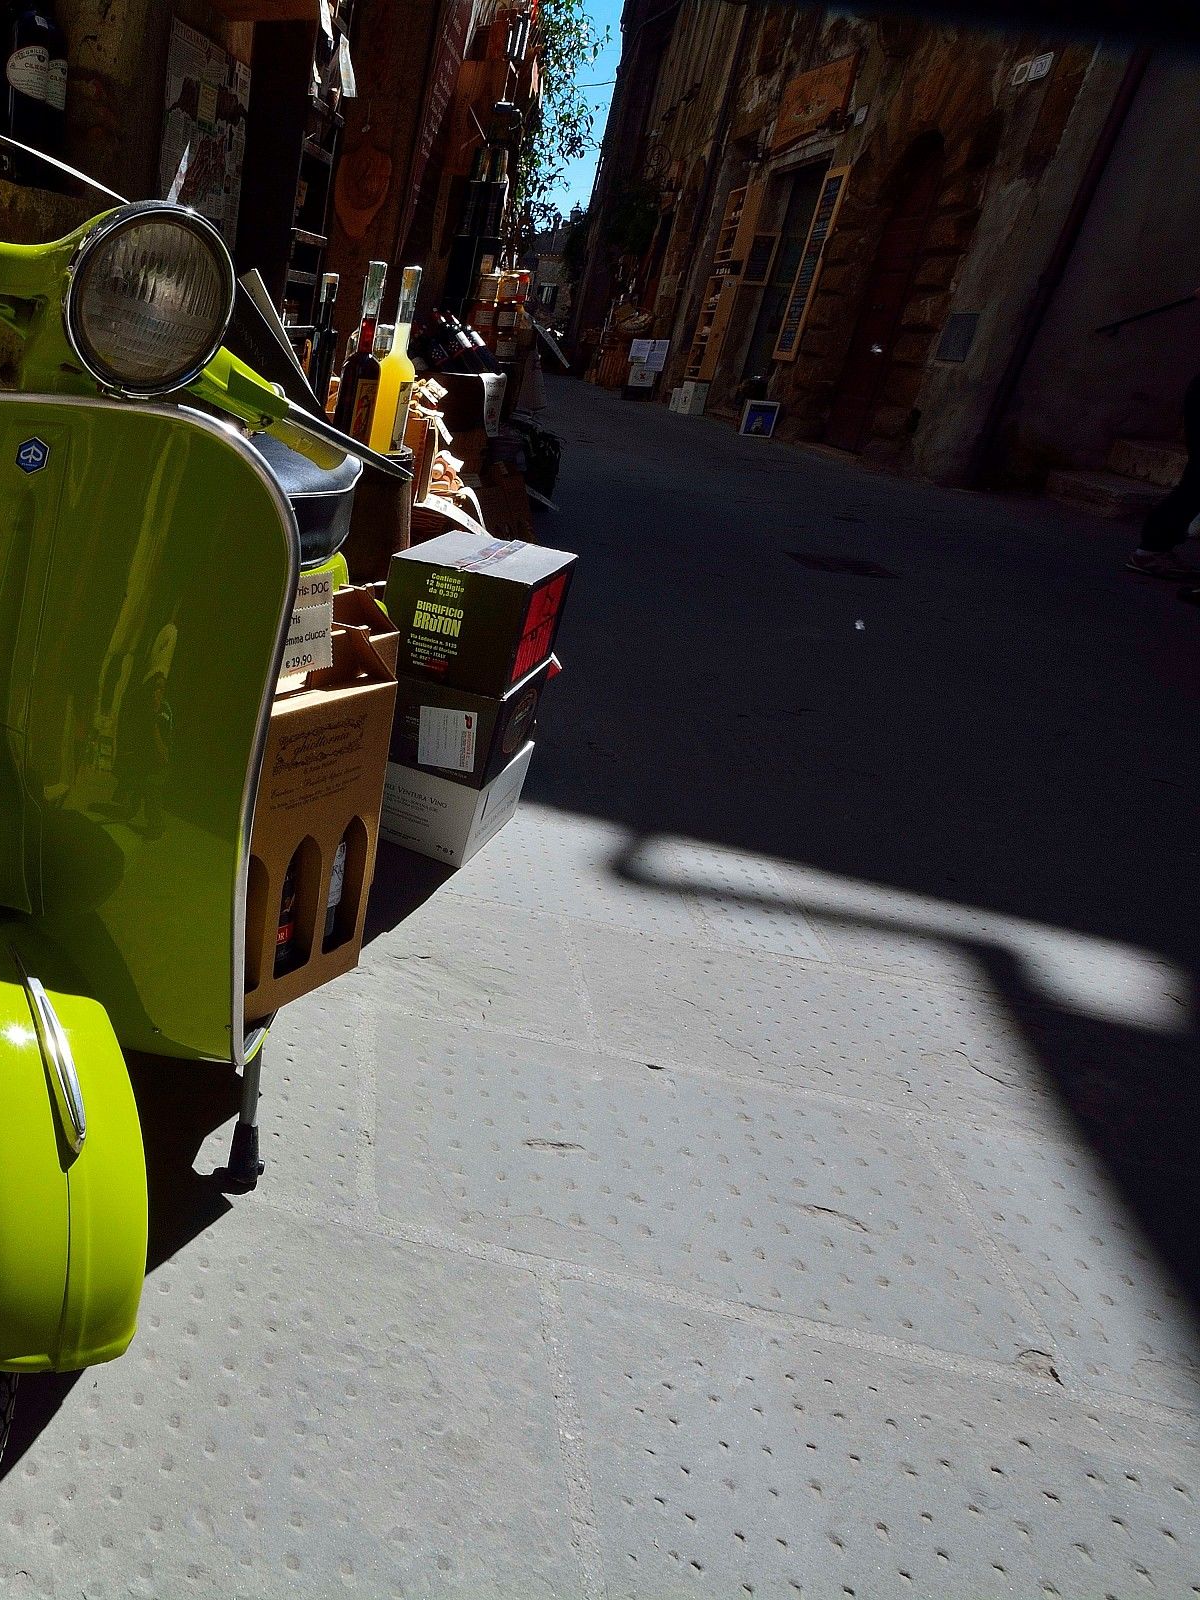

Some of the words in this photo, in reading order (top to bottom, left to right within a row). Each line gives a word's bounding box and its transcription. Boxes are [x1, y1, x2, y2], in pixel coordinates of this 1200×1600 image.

[431, 572, 462, 585] Contiene
[311, 581, 329, 595] DOC
[428, 586, 438, 594] da
[438, 588, 459, 599] 0,330
[435, 580, 465, 593] bottiglie
[416, 600, 464, 619] BIRRIFICIO
[415, 646, 430, 655] LUCCA
[433, 651, 447, 659] ITALY
[291, 654, 312, 668] 19,90
[398, 784, 428, 803] VENTURA
[429, 797, 448, 809] VINO
